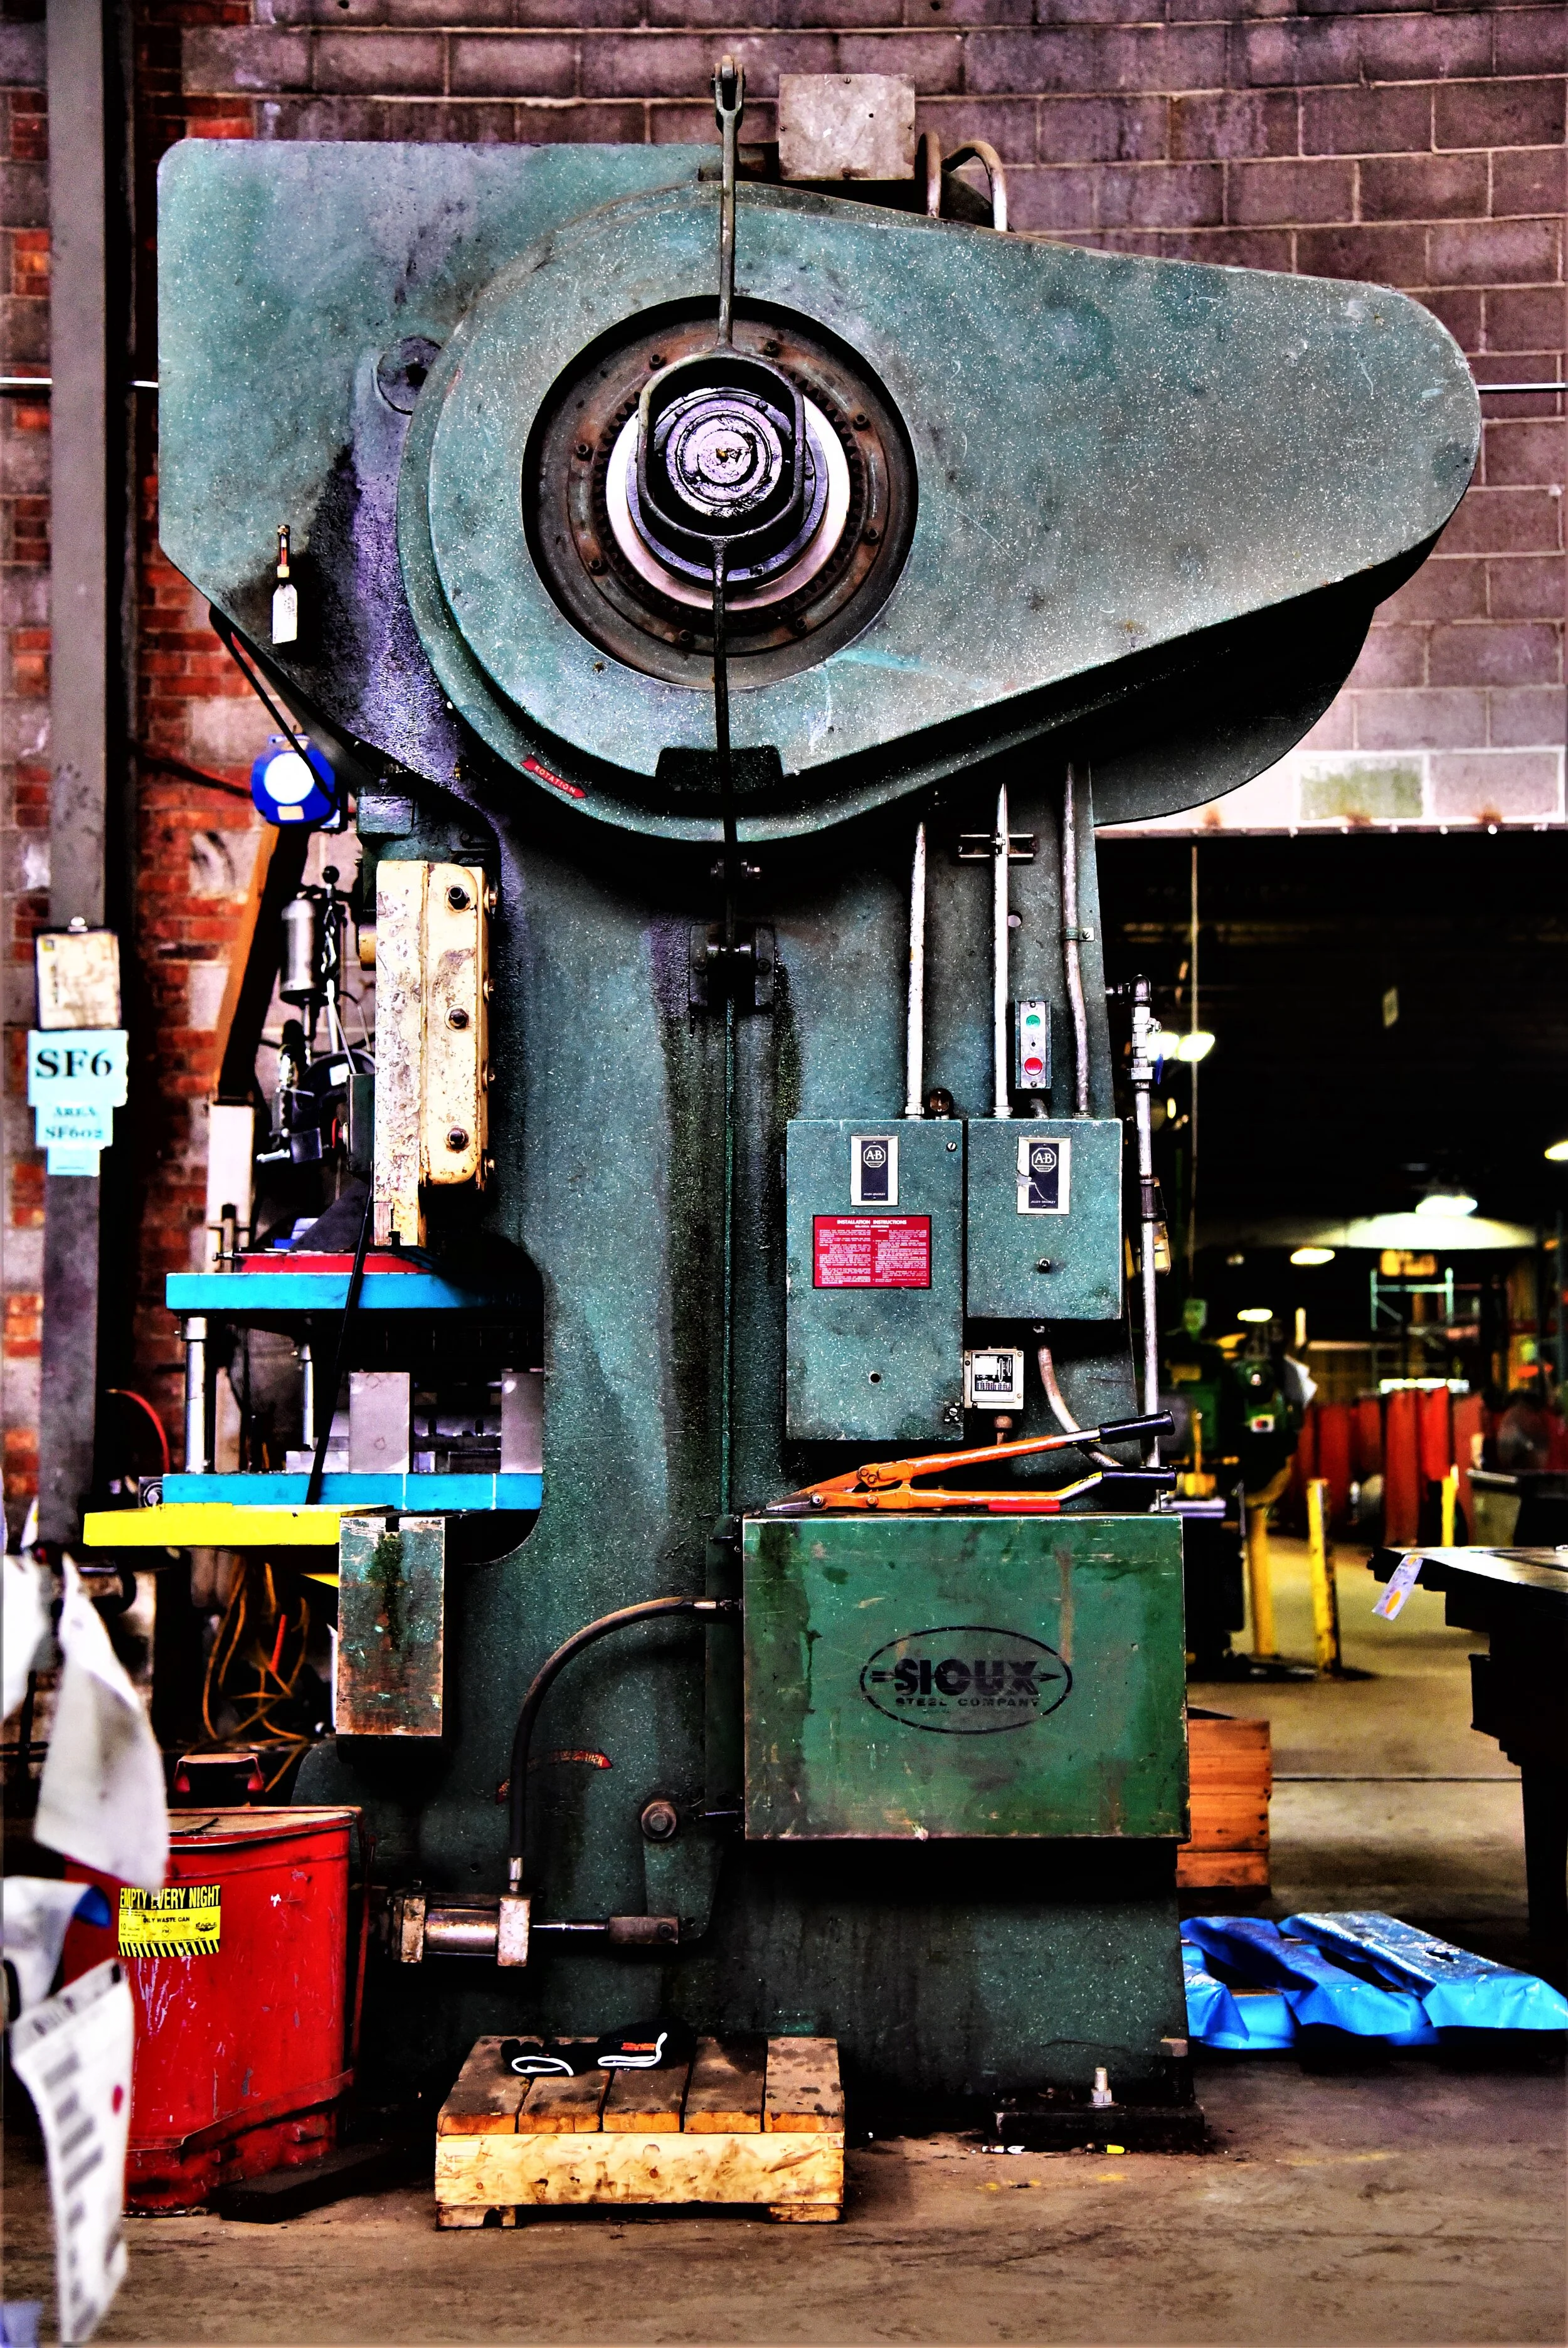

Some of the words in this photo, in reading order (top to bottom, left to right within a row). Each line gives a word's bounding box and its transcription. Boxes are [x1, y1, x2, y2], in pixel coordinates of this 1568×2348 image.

[534, 765, 576, 793] ROTATION
[35, 1047, 112, 1078] SF6
[53, 1106, 97, 1117] AREA
[45, 1126, 103, 1139] SF602
[894, 1658, 1039, 1696] SIOUX
[896, 1698, 947, 1706] STEEL
[958, 1698, 1039, 1706] COMPANY
[120, 1888, 147, 1909] EMPTY
[151, 1888, 186, 1909] EVERY
[189, 1885, 221, 1908] NIGHT
